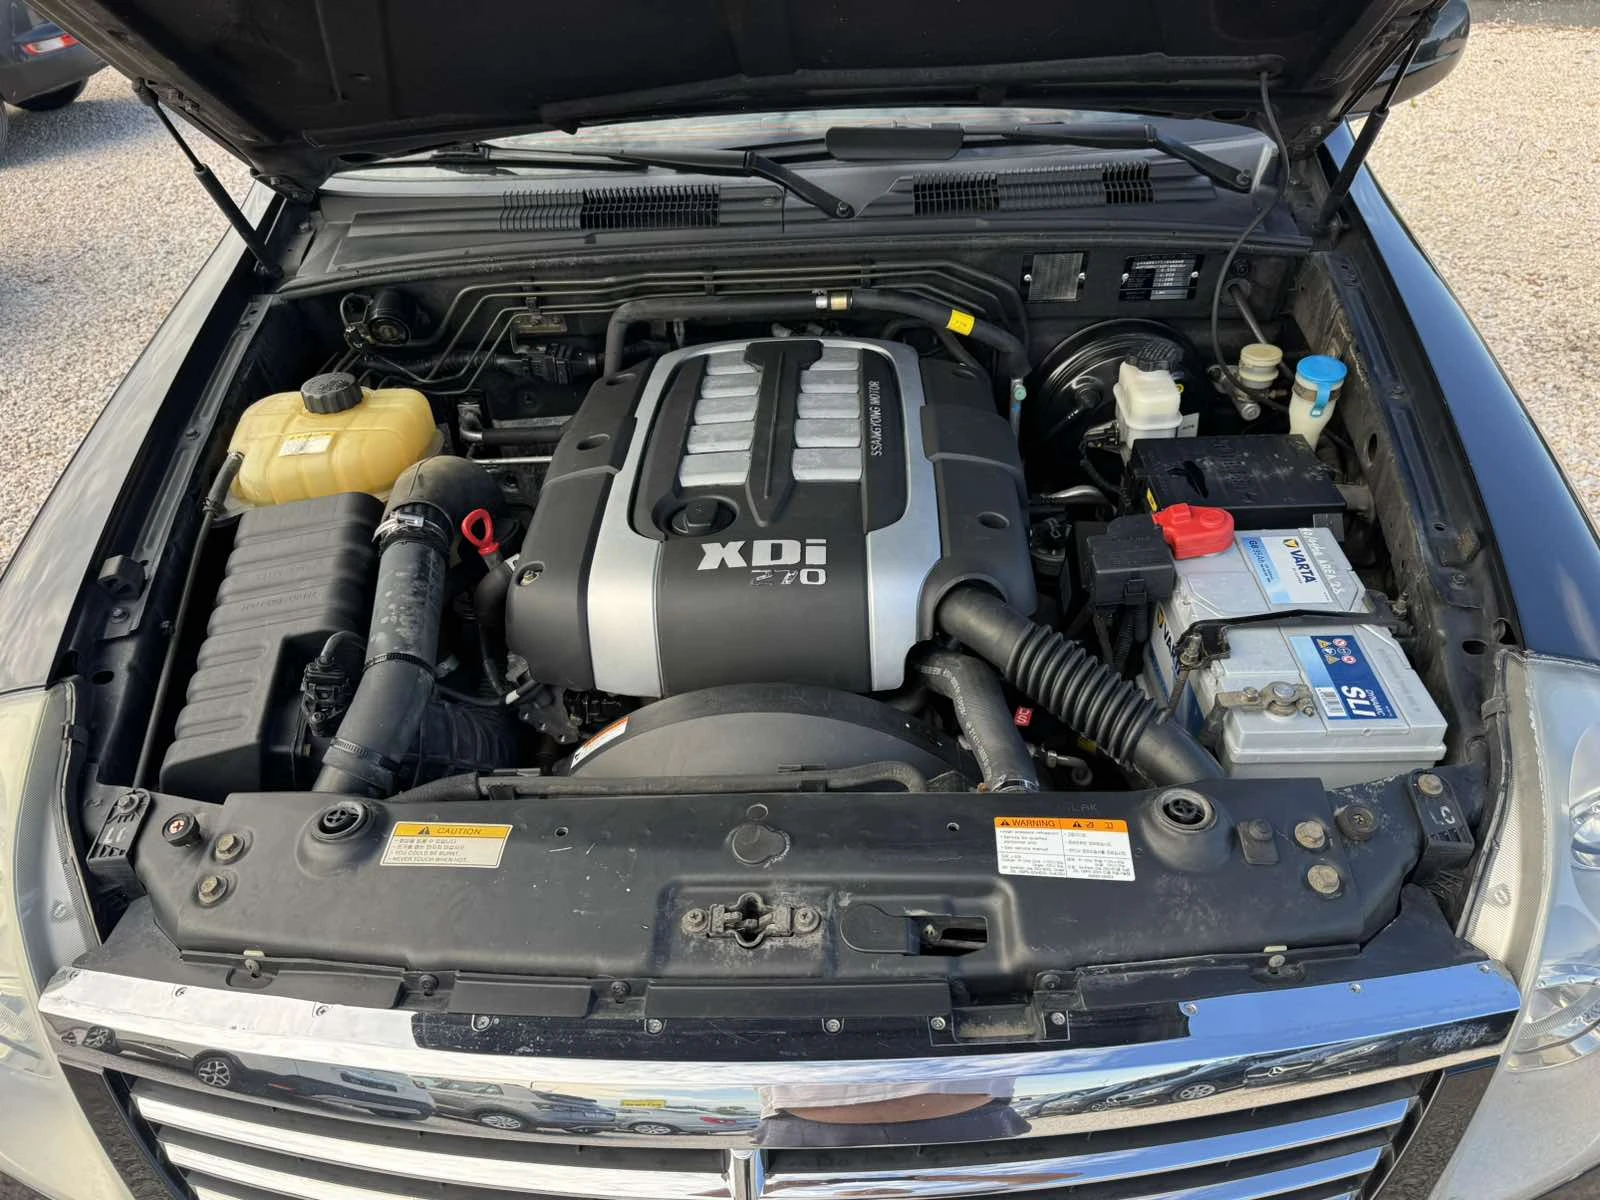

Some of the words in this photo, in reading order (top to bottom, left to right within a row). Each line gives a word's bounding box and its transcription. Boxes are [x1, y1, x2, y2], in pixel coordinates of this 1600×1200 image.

[868, 381, 881, 406] MOTOR
[870, 406, 882, 456] SSANGYONG
[696, 538, 827, 571] XDi
[1290, 549, 1317, 583] VARTA
[1341, 685, 1377, 717] SLI
[437, 827, 483, 835] CAUTION
[1012, 819, 1055, 828] WARNING
